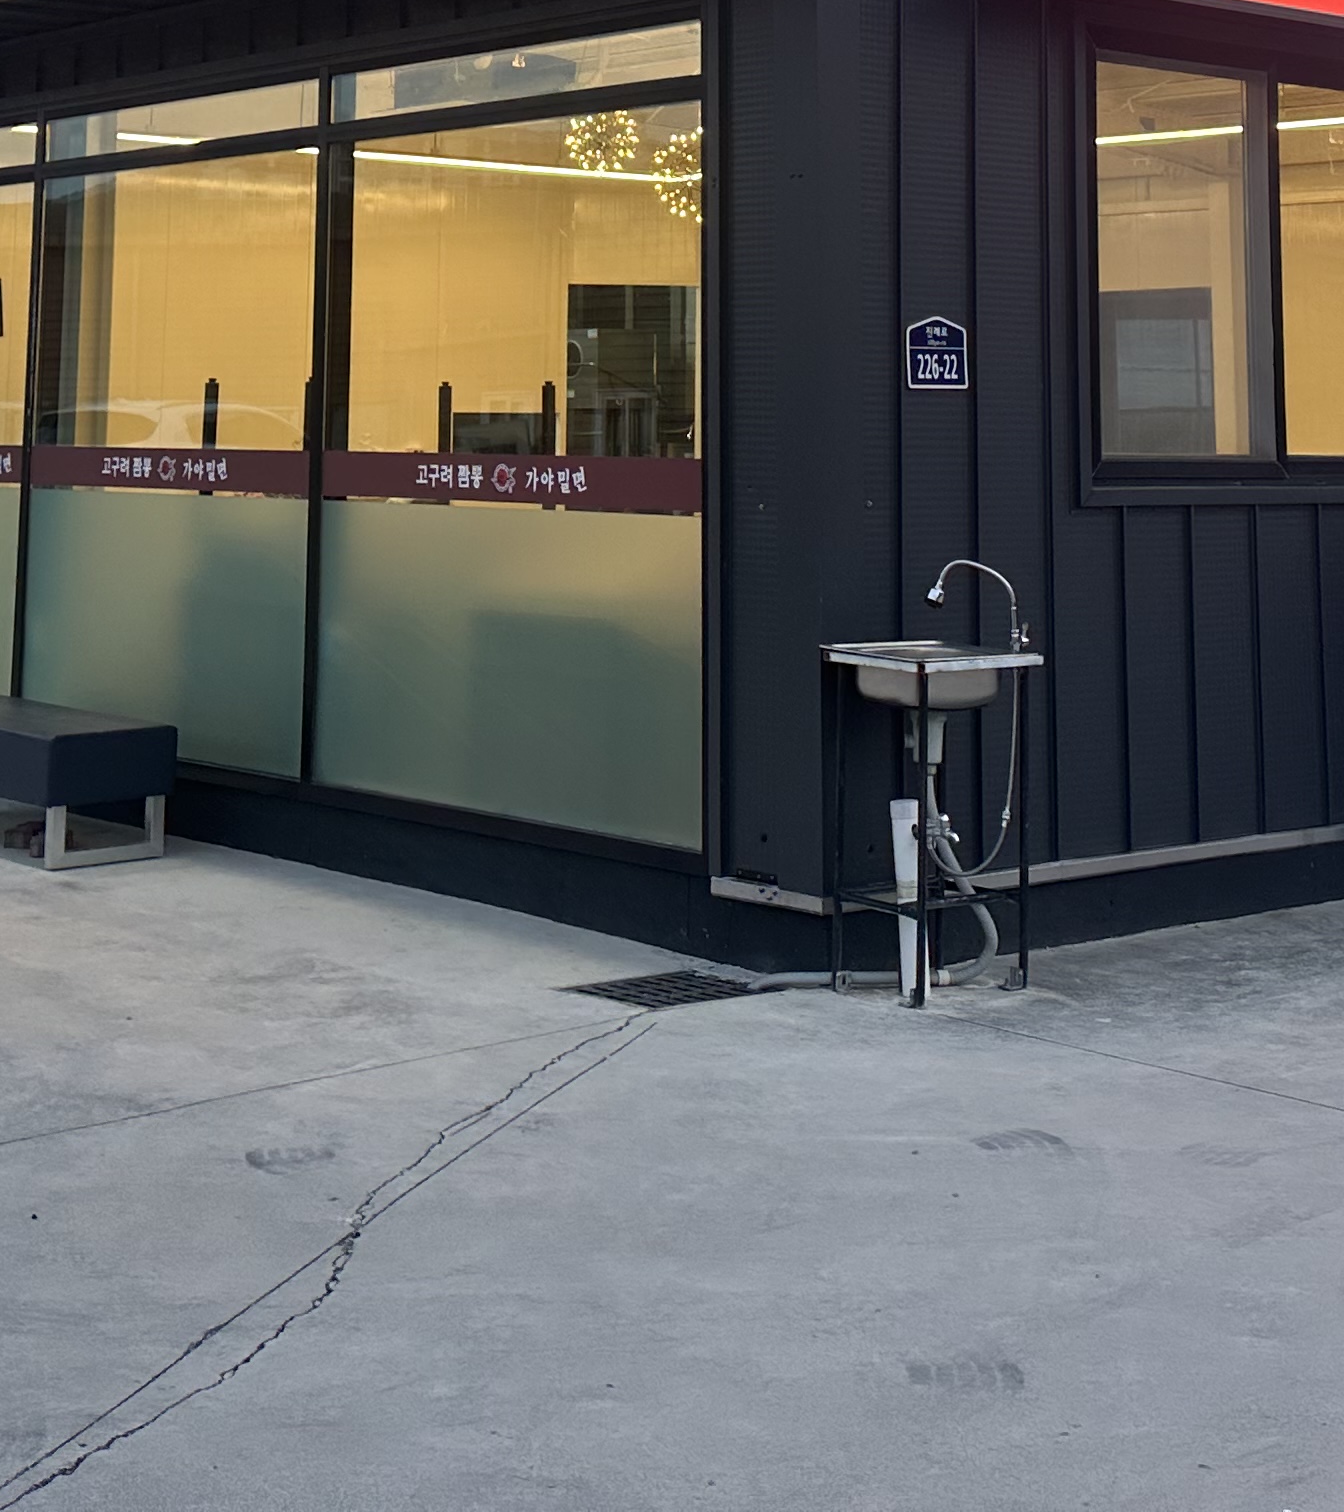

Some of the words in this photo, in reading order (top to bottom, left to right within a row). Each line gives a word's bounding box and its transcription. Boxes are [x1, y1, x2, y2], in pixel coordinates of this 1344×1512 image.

[917, 354, 958, 380] 226-22
[101, 456, 130, 478] 고구려
[415, 464, 453, 488] 고구려
[457, 464, 484, 489] 짬뽕
